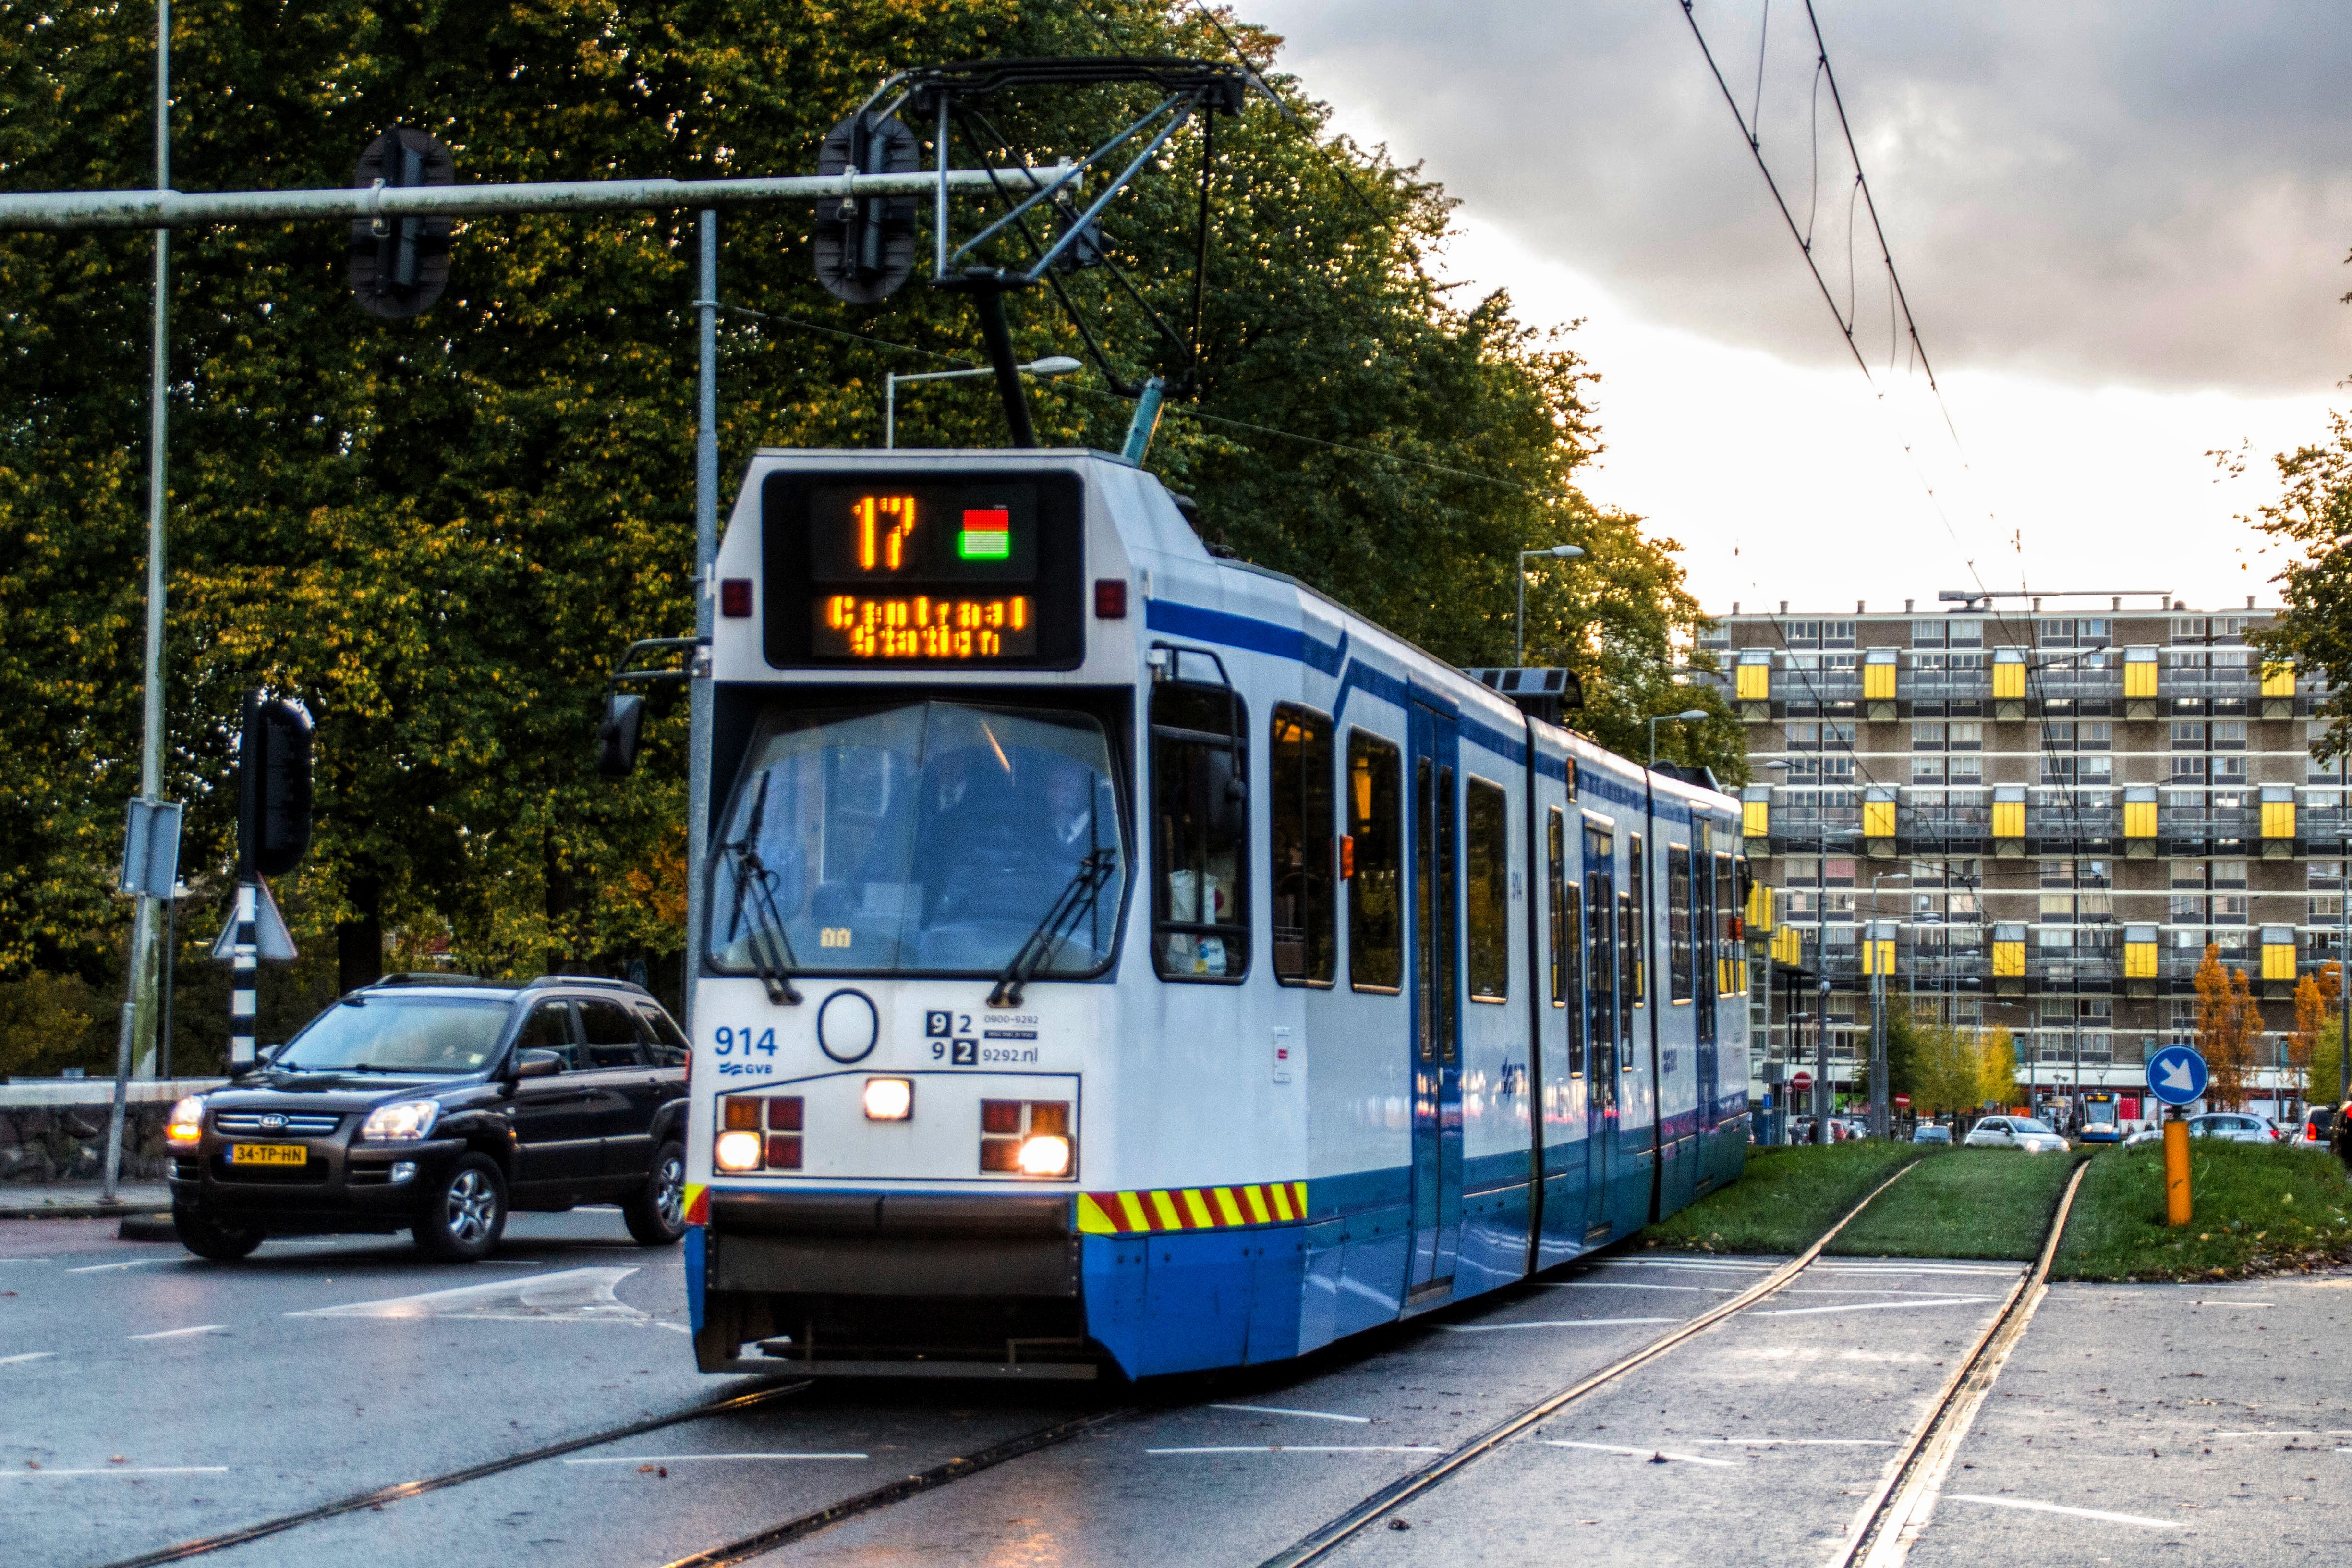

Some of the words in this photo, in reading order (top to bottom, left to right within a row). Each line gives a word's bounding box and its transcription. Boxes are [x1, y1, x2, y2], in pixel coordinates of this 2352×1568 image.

[855, 497, 915, 570] 17
[852, 625, 1000, 657] Station
[984, 1015, 1038, 1024] 0900-9292
[715, 1026, 778, 1056] 914
[984, 1047, 1038, 1062] 9292.nl
[745, 1064, 773, 1074] GVB
[237, 1146, 303, 1162] 34-TP-HN
